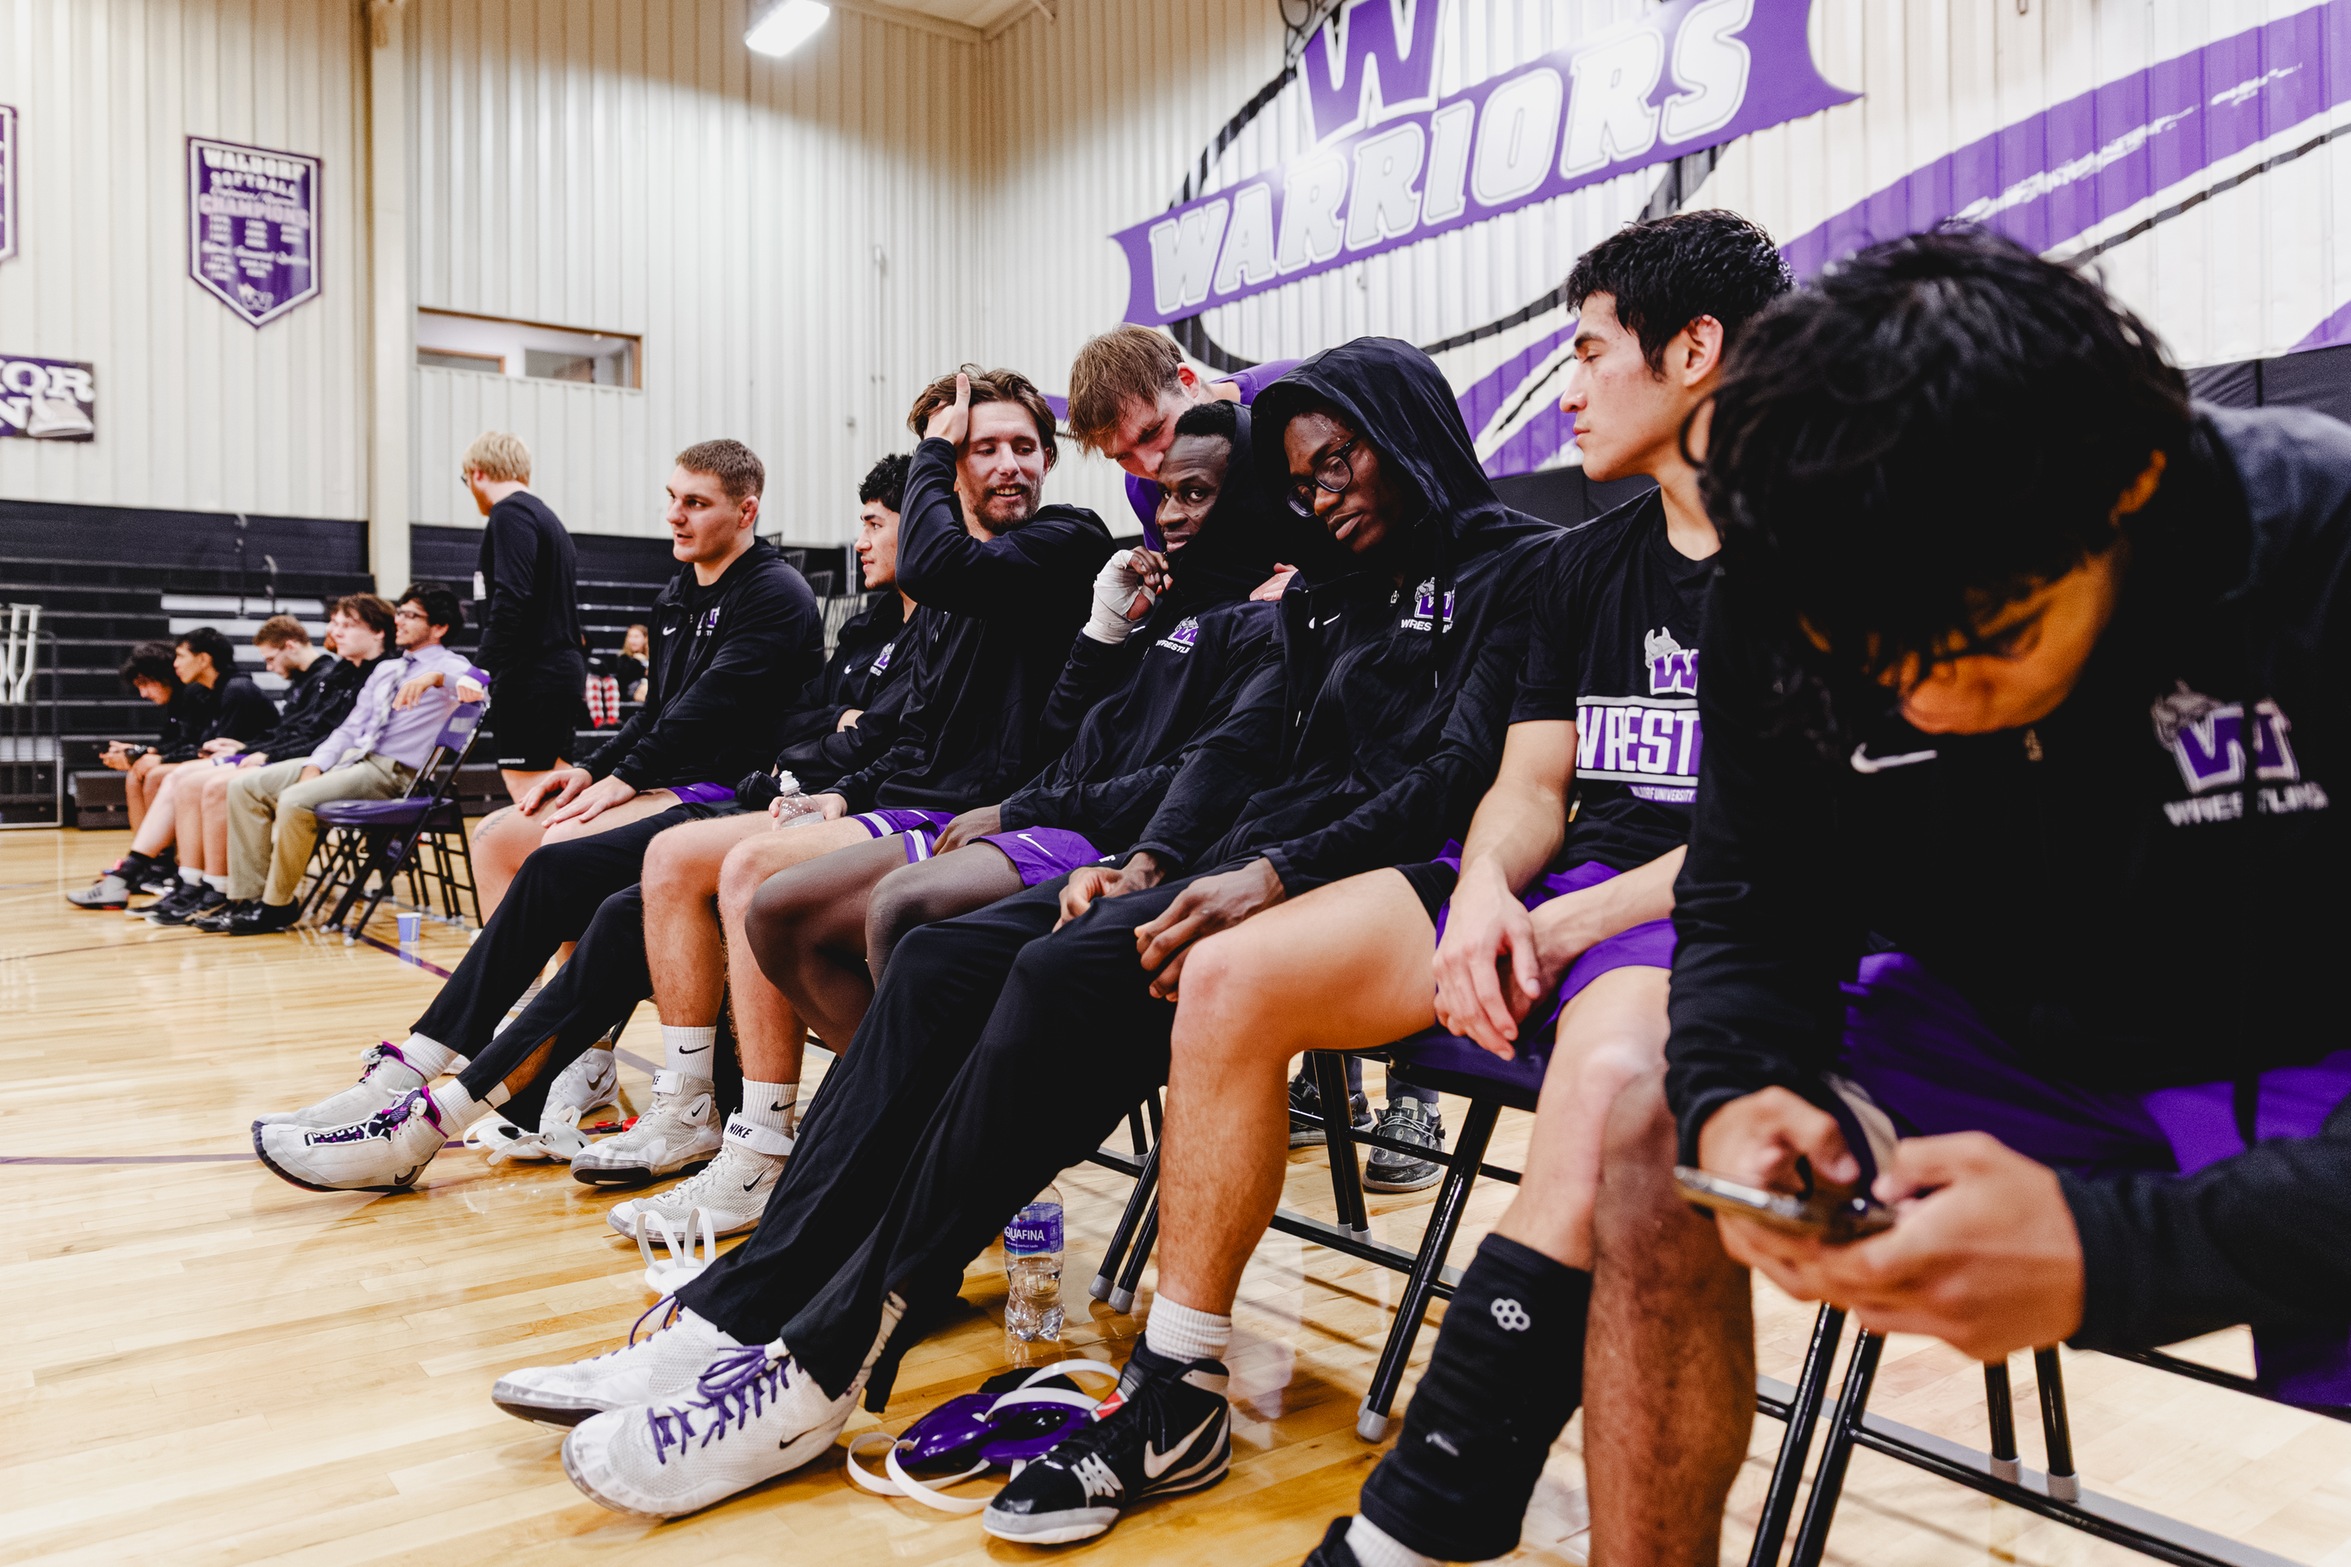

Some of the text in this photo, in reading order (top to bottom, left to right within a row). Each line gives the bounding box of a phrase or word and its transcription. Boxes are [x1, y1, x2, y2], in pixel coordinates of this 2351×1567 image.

[1149, 0, 1754, 316] WARRIORS
[210, 171, 298, 199] SOFTBALL
[199, 193, 309, 230] CHAMPIONS
[0, 359, 95, 403] OR
[1649, 648, 1699, 696] W
[728, 1122, 753, 1139] NIKE
[1004, 1226, 1045, 1242] QUAFINA
